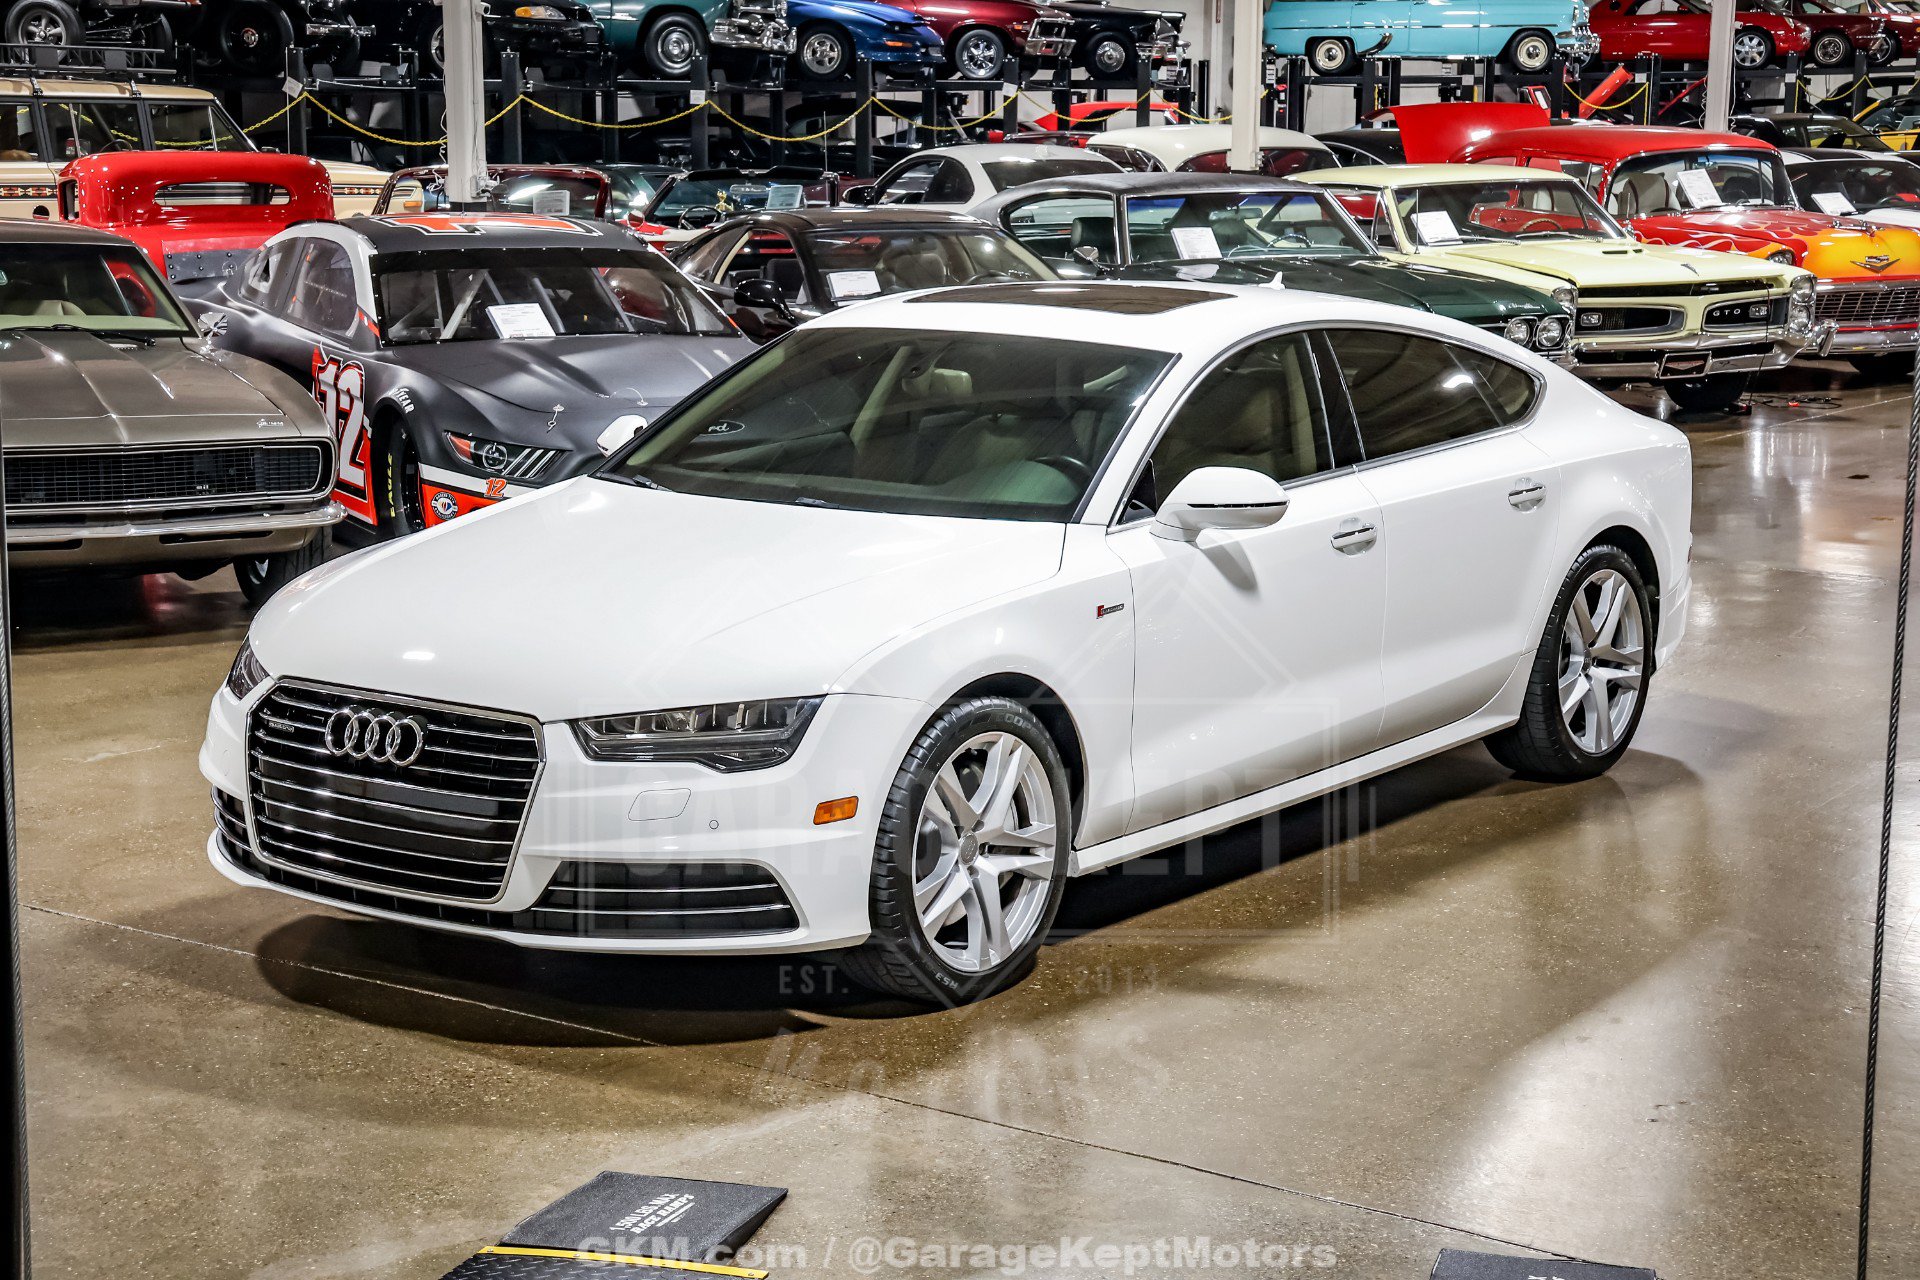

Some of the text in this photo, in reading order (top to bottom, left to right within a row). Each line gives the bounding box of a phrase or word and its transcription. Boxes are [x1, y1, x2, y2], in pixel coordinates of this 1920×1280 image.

[1712, 308, 1741, 317] GTO
[316, 357, 366, 494] 12
[484, 477, 507, 498] 12
[629, 1214, 662, 1234] RACE
[656, 1193, 695, 1217] RAMPS
